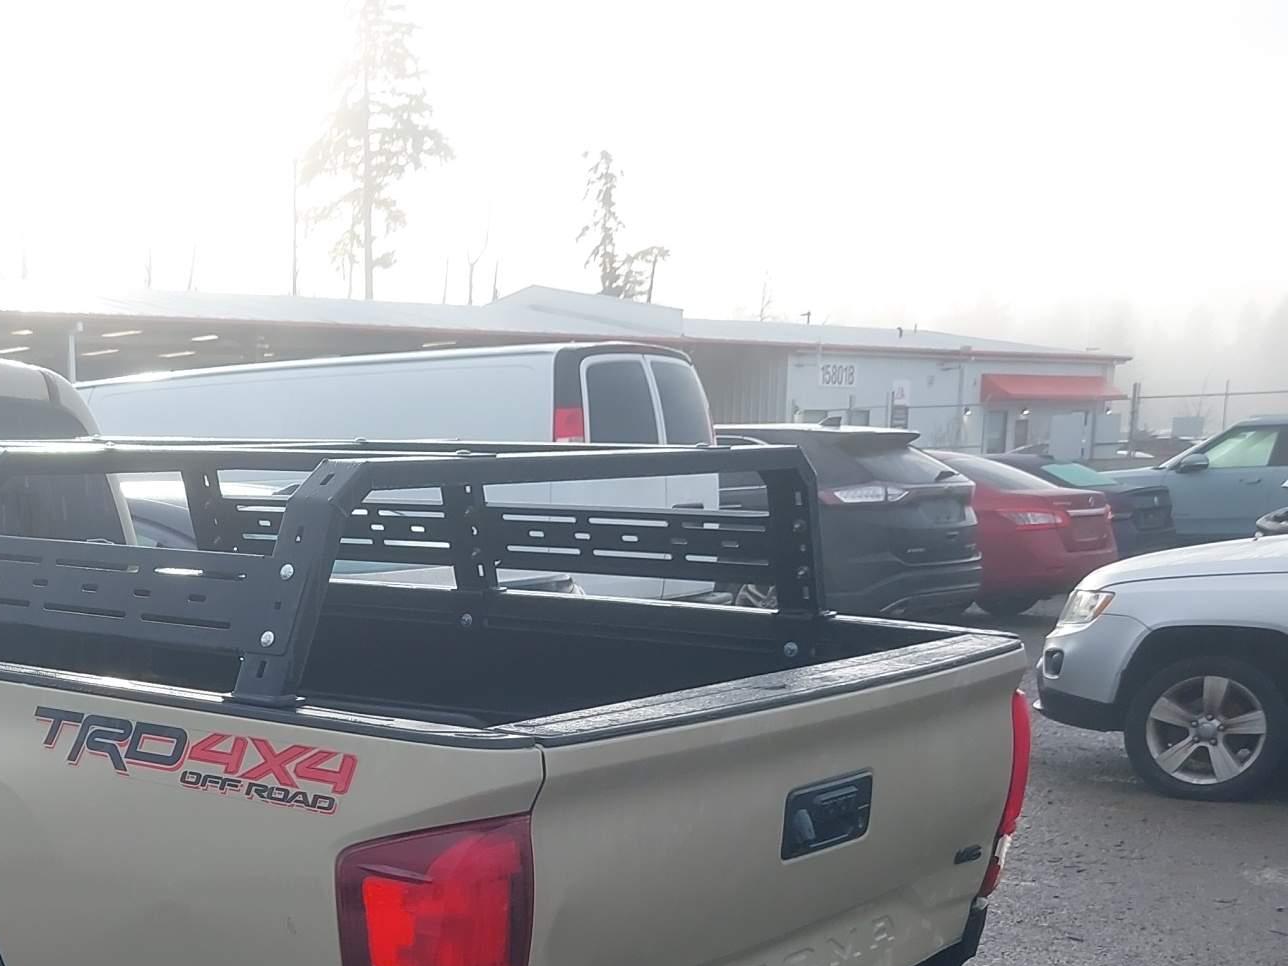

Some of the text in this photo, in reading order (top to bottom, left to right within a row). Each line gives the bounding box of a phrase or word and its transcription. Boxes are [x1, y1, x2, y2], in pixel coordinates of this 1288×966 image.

[34, 705, 189, 777] TRD
[179, 769, 337, 816] OFF ROAD
